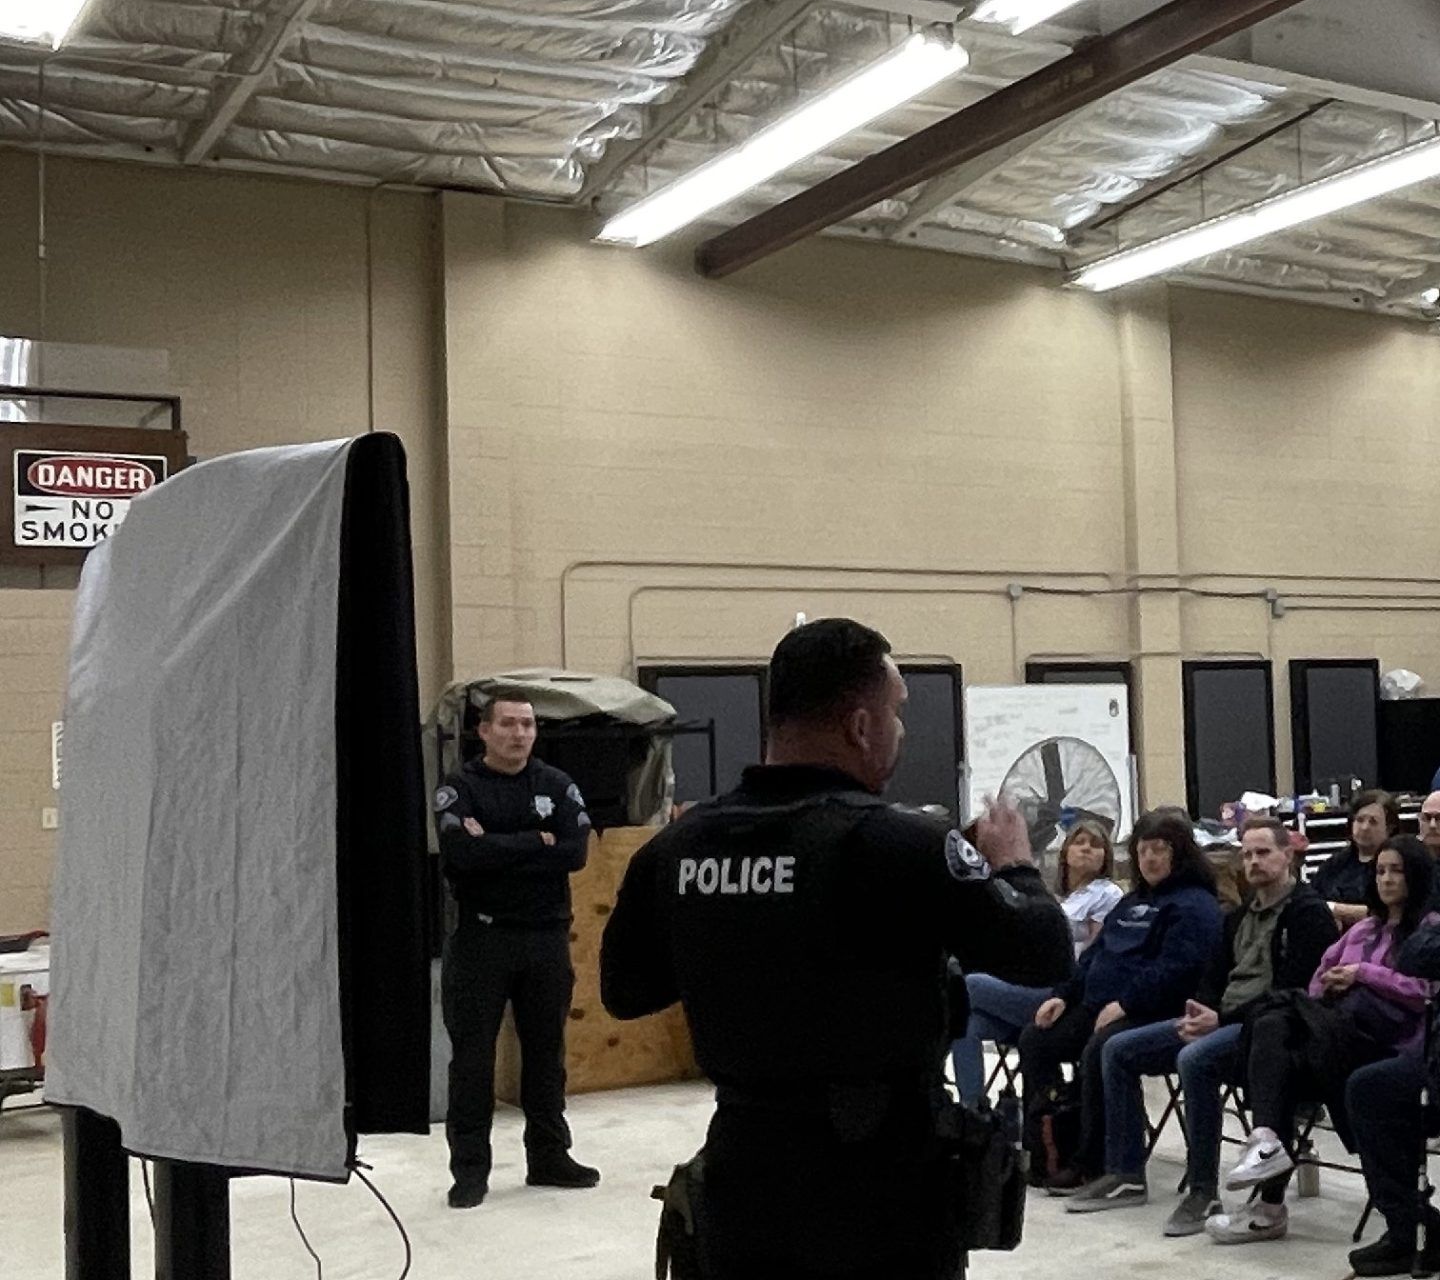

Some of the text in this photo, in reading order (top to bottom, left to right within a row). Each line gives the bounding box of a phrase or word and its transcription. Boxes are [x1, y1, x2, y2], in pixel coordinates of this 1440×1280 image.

[37, 464, 148, 490] DANGER
[71, 500, 115, 520] NO
[21, 520, 119, 542] SMOK
[678, 855, 796, 895] POLICE
